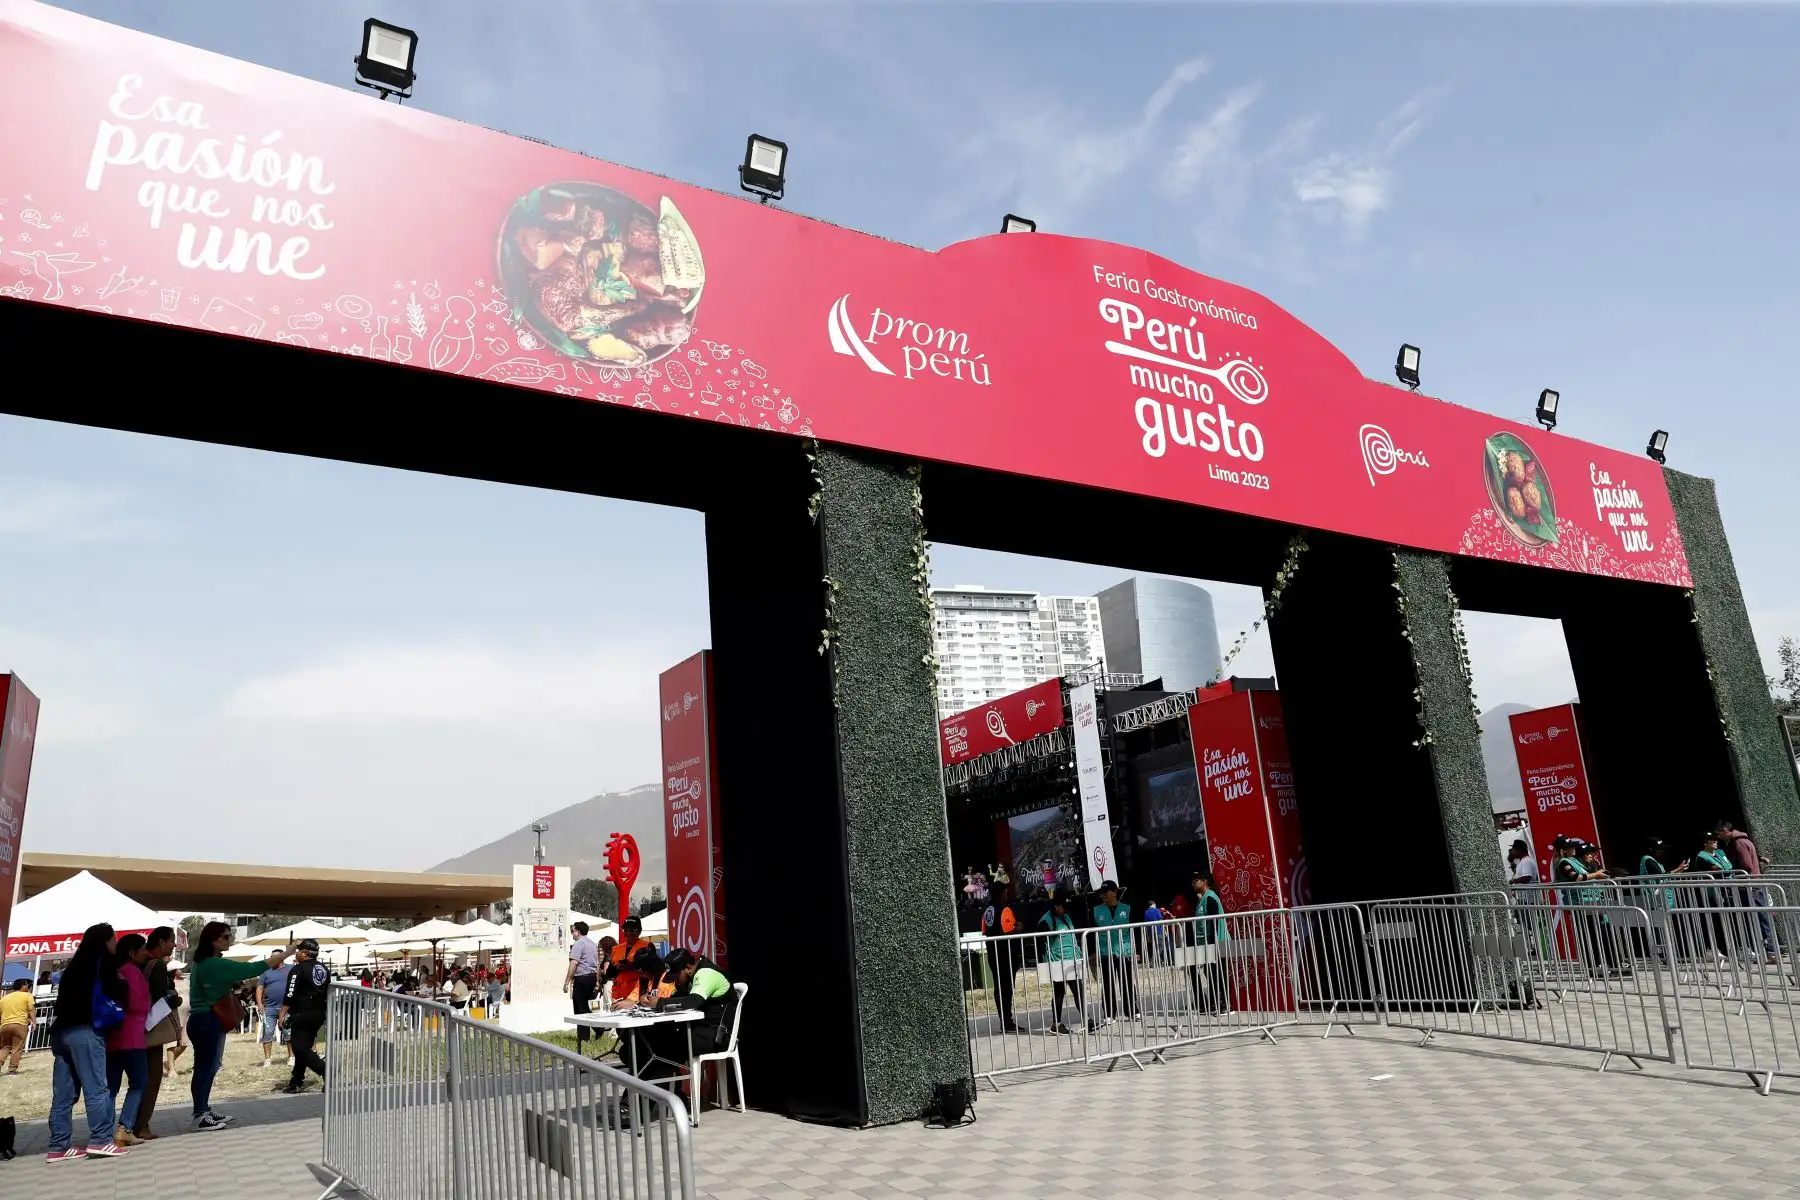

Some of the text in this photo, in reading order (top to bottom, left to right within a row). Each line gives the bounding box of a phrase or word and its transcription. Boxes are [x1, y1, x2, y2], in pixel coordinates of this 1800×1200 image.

[108, 73, 208, 129] Esa
[85, 119, 335, 194] pasión
[138, 181, 334, 230] que nos
[177, 223, 325, 280] une
[1093, 265, 1257, 330] Feria Gastronómica
[864, 308, 970, 354] prom
[1099, 298, 1207, 361] Perú
[902, 345, 992, 385] perú
[1129, 364, 1214, 404] mucho
[1135, 397, 1264, 462] gusto
[1208, 464, 1270, 490] Lima 2023
[1590, 462, 1612, 485] Esa
[1592, 480, 1643, 522] pasión
[1608, 512, 1648, 536] que nos
[1621, 530, 1654, 552] une
[1203, 748, 1221, 763] Esa
[1204, 748, 1249, 788] pasión
[668, 769, 688, 793] Perú
[1214, 766, 1251, 792] que nos
[1223, 780, 1253, 801] une
[1528, 772, 1558, 786] Perú
[1536, 787, 1560, 796] mucho
[1537, 791, 1576, 811] gusto
[672, 805, 699, 837] gusto
[10, 937, 81, 954] ZONA TÉC
